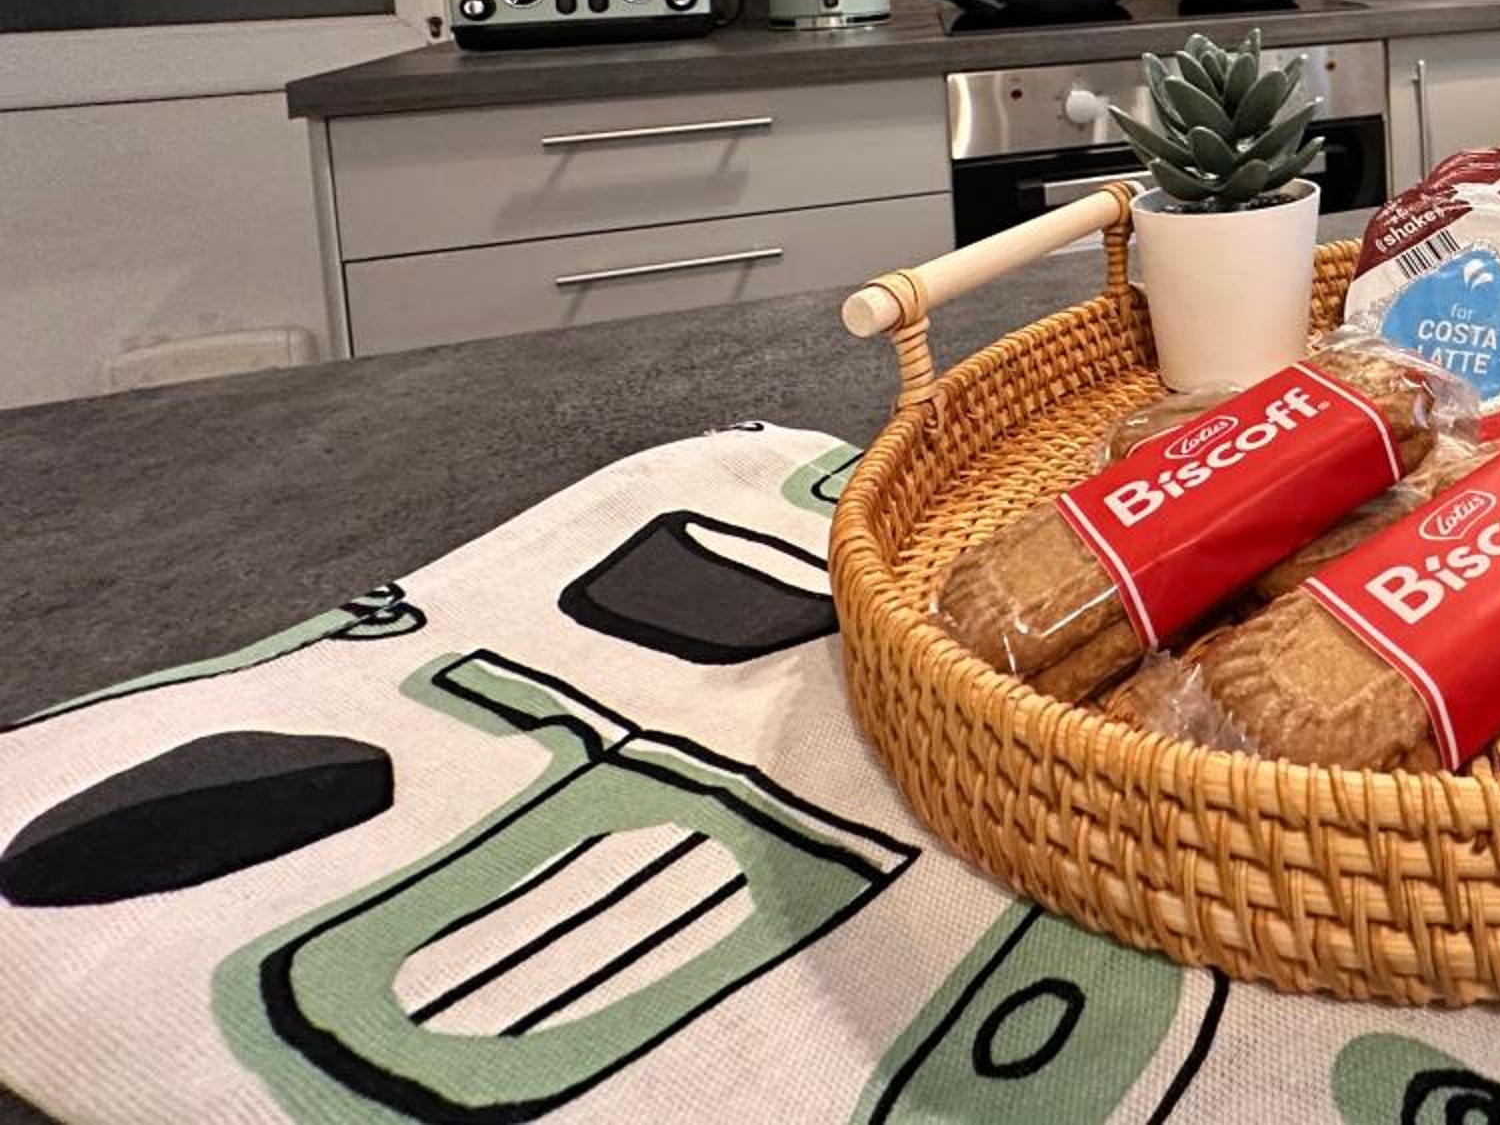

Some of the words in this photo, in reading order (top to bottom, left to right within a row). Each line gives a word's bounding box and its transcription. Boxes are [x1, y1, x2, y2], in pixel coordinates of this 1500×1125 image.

[1450, 302, 1473, 321] for
[1418, 319, 1498, 350] COSTA
[1181, 421, 1230, 454] Lotus
[1103, 386, 1319, 528] Biscoff
[1436, 496, 1487, 535] Lotus
